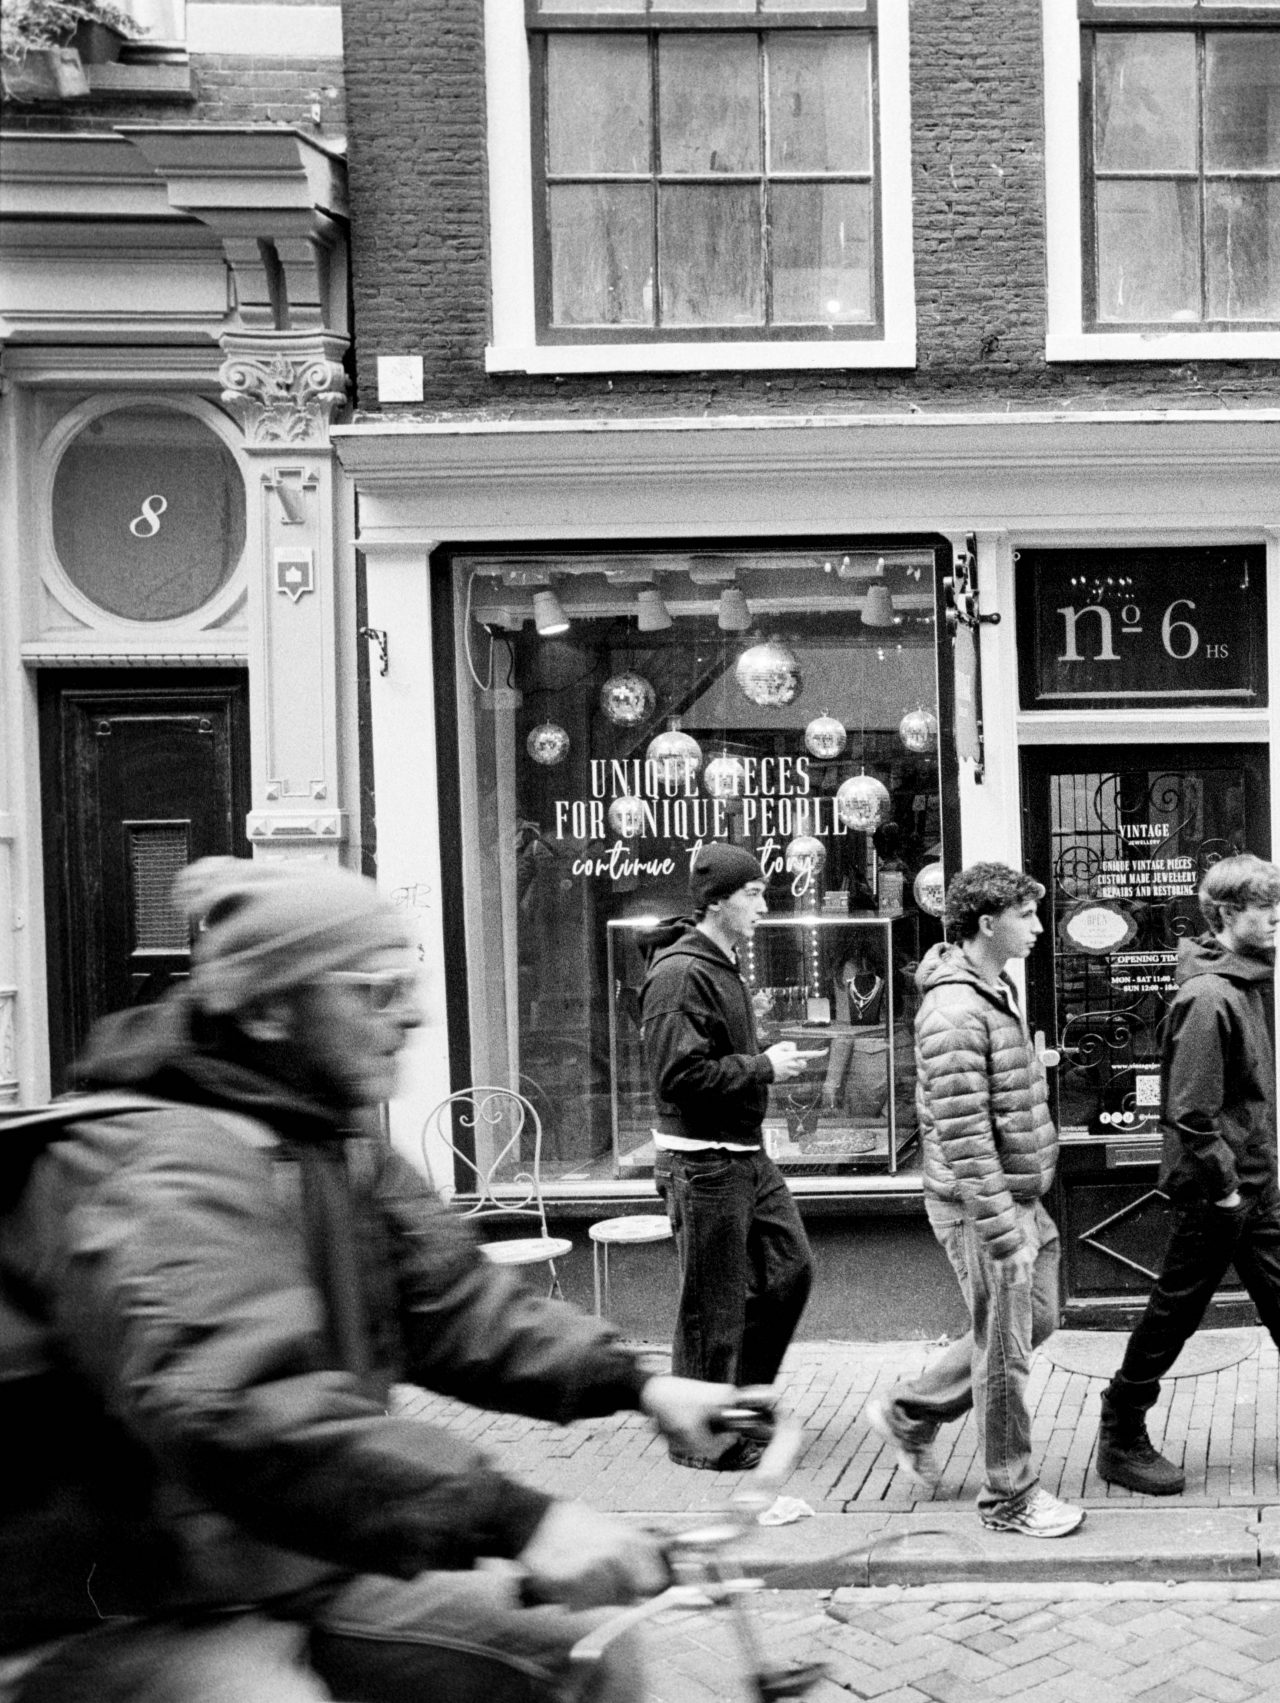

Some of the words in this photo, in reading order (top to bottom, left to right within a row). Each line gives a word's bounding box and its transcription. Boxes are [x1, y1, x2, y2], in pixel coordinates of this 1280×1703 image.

[130, 494, 168, 538] 8
[1161, 599, 1199, 660] 6
[1206, 644, 1229, 658] HS
[590, 757, 700, 799] UNIQUE
[554, 800, 606, 840] FOR
[620, 798, 728, 840] UNIQUE
[741, 797, 848, 837] PEOPLE
[1118, 823, 1170, 838] VINTAGE
[571, 839, 676, 881] continue
[755, 837, 812, 897] tory
[1102, 860, 1130, 872] UNIQUE
[1131, 859, 1166, 871] VINTAGE
[1167, 858, 1192, 870] PIECES
[1097, 873, 1127, 885] CUSTOM
[1129, 872, 1151, 884] MADE
[1153, 871, 1197, 883] JEWELLERY
[1102, 886, 1134, 898] REPAIRS
[1135, 885, 1151, 897] AND
[1152, 884, 1194, 897] RESTORING
[1117, 954, 1160, 964] OPENING
[1160, 953, 1179, 963] TIM
[1110, 976, 1131, 985] MON
[1136, 975, 1152, 983] SAT
[1123, 984, 1140, 992] SUN
[1141, 984, 1159, 992] 12:00
